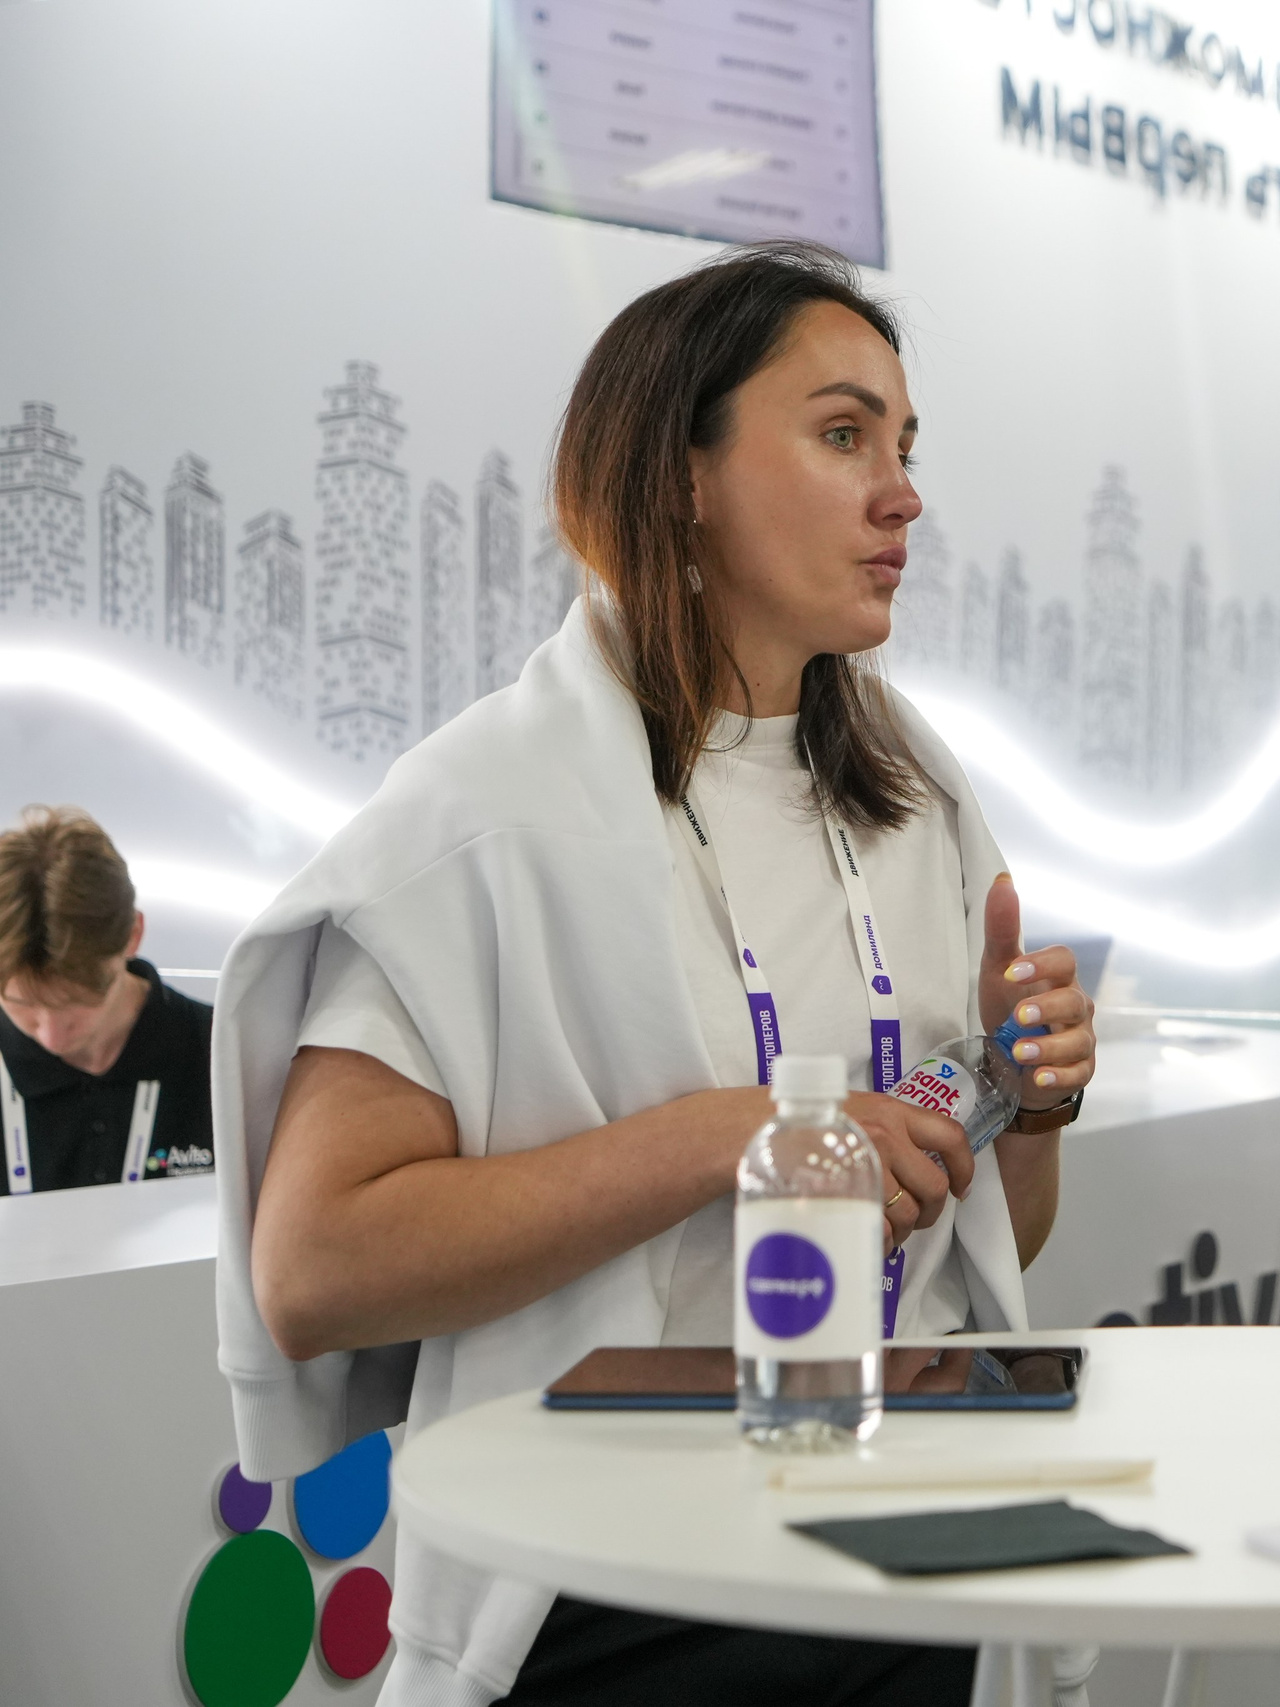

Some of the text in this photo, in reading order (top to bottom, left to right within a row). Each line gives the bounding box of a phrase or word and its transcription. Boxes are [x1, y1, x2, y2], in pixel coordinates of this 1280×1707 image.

[840, 828, 859, 877] ДВИЖЕНИЕ
[910, 1070, 960, 1106] saint
[167, 1145, 213, 1167] Avito
